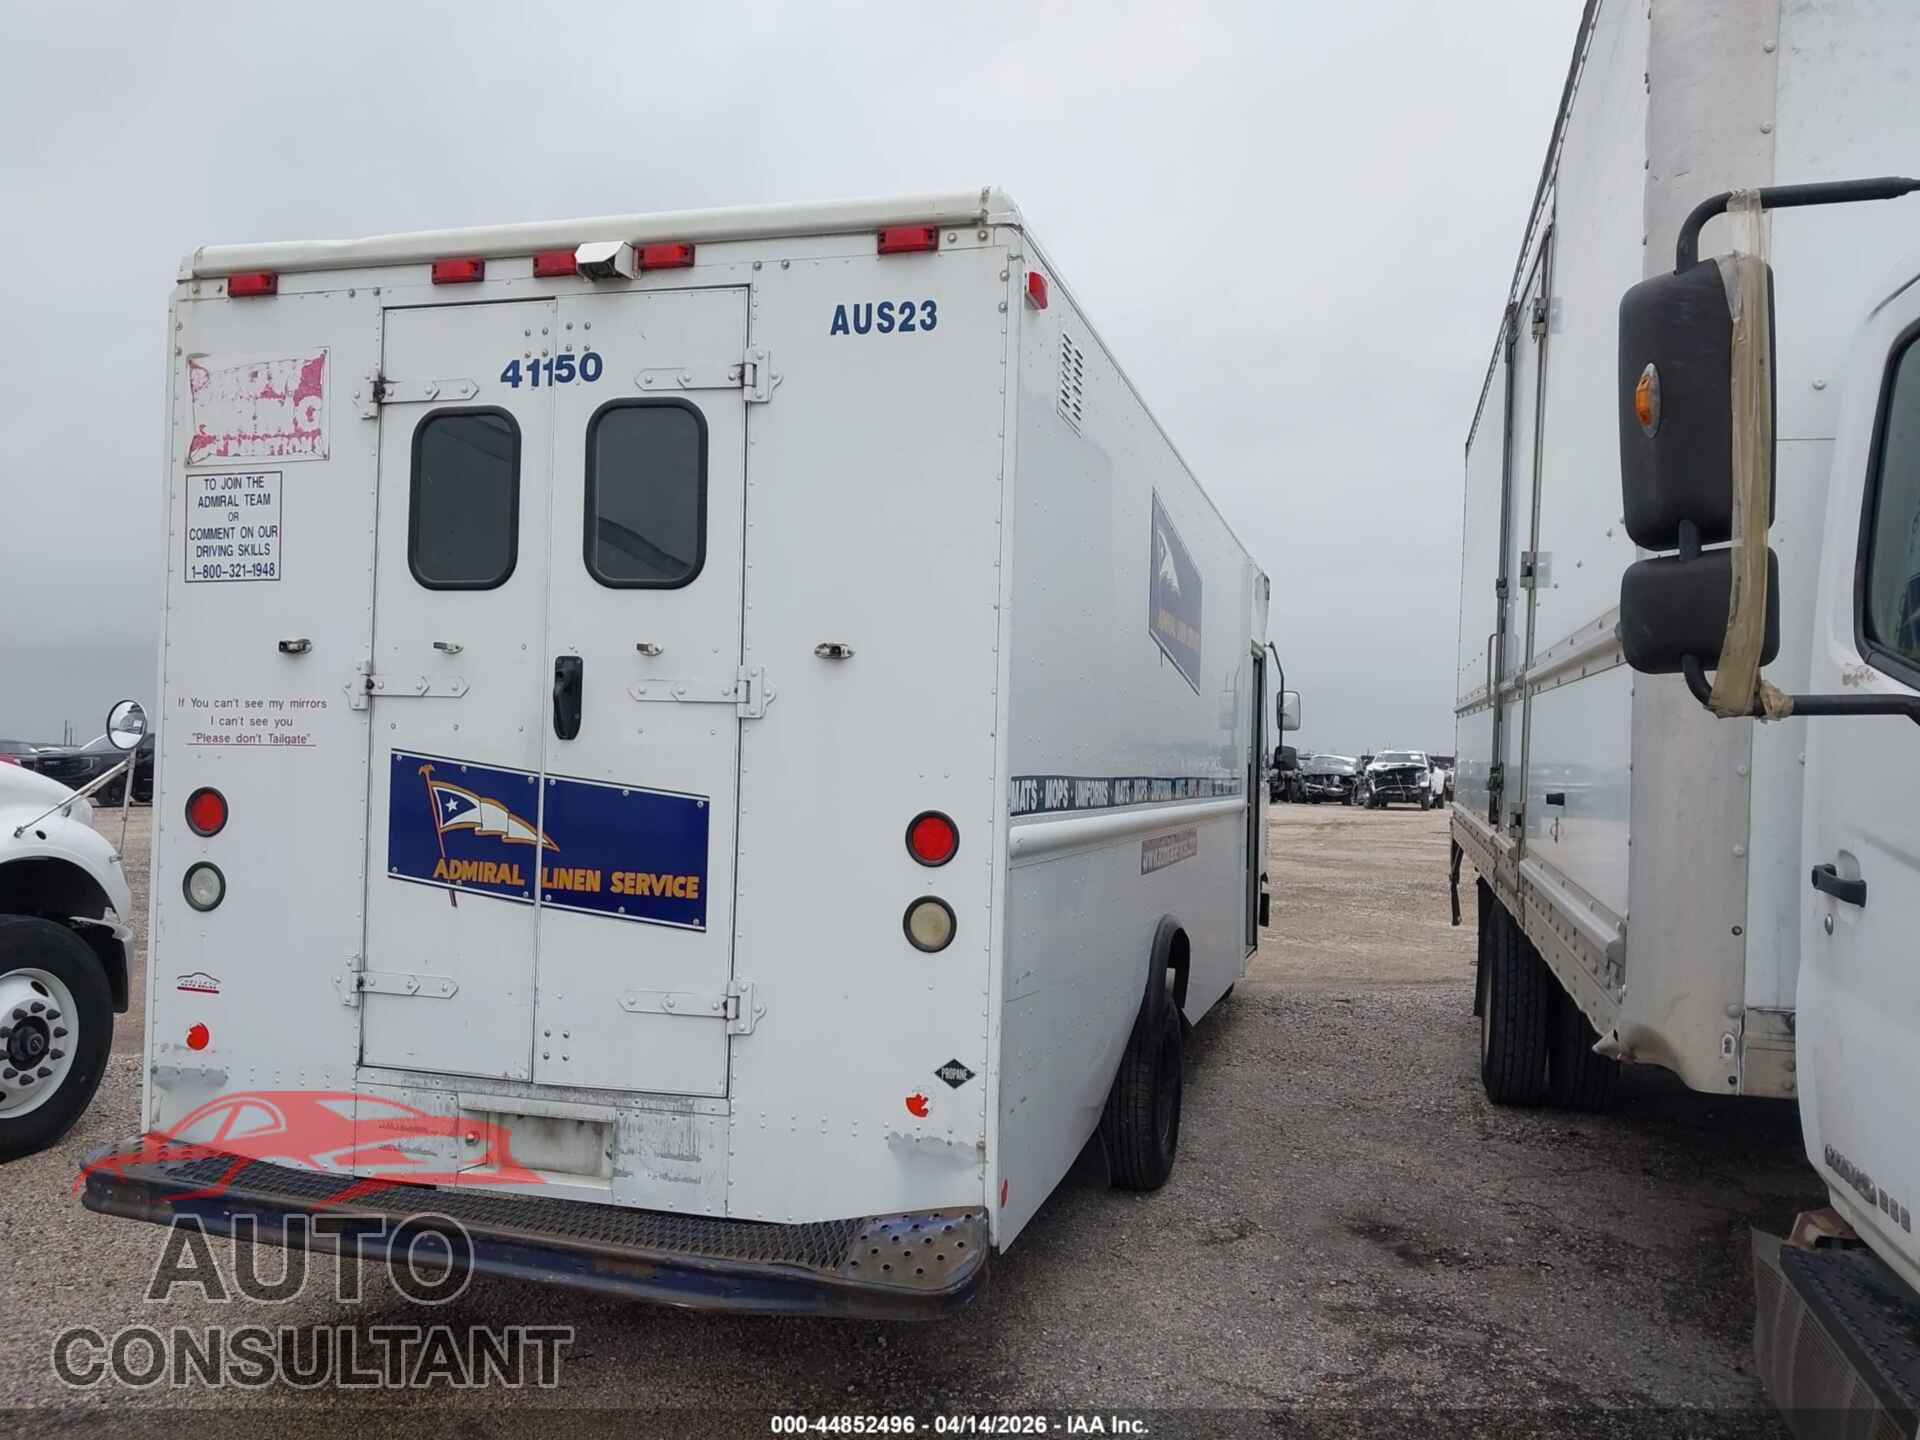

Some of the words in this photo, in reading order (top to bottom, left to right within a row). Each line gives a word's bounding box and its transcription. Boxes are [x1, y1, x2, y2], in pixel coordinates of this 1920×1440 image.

[830, 299, 938, 335] AUS23
[500, 352, 603, 388] 41150
[204, 478, 216, 490] TO
[221, 477, 242, 490] JOIN
[246, 476, 264, 489] THE
[198, 495, 239, 508] ADMIRAL
[244, 493, 271, 506] TEAM
[228, 512, 239, 522] OR
[189, 527, 235, 541] COMMENT
[240, 526, 254, 539] ON
[258, 525, 278, 538] OUR
[196, 545, 234, 558] DRIVING
[238, 543, 271, 556] SKILLS
[191, 563, 275, 578] 1-800-321-1948
[191, 698, 209, 708] You
[214, 698, 239, 708] can't
[244, 699, 263, 708] see
[269, 699, 284, 710] my
[290, 698, 327, 709] mirrors
[219, 716, 244, 726] can't
[250, 718, 268, 726] see
[274, 718, 293, 729] you
[236, 733, 262, 743] don't
[1009, 779, 1037, 812] MATS
[1045, 779, 1069, 808] MOPS
[433, 858, 526, 887] ADMIRAL
[541, 866, 601, 893] LINEN
[610, 871, 700, 900] SERVICE
